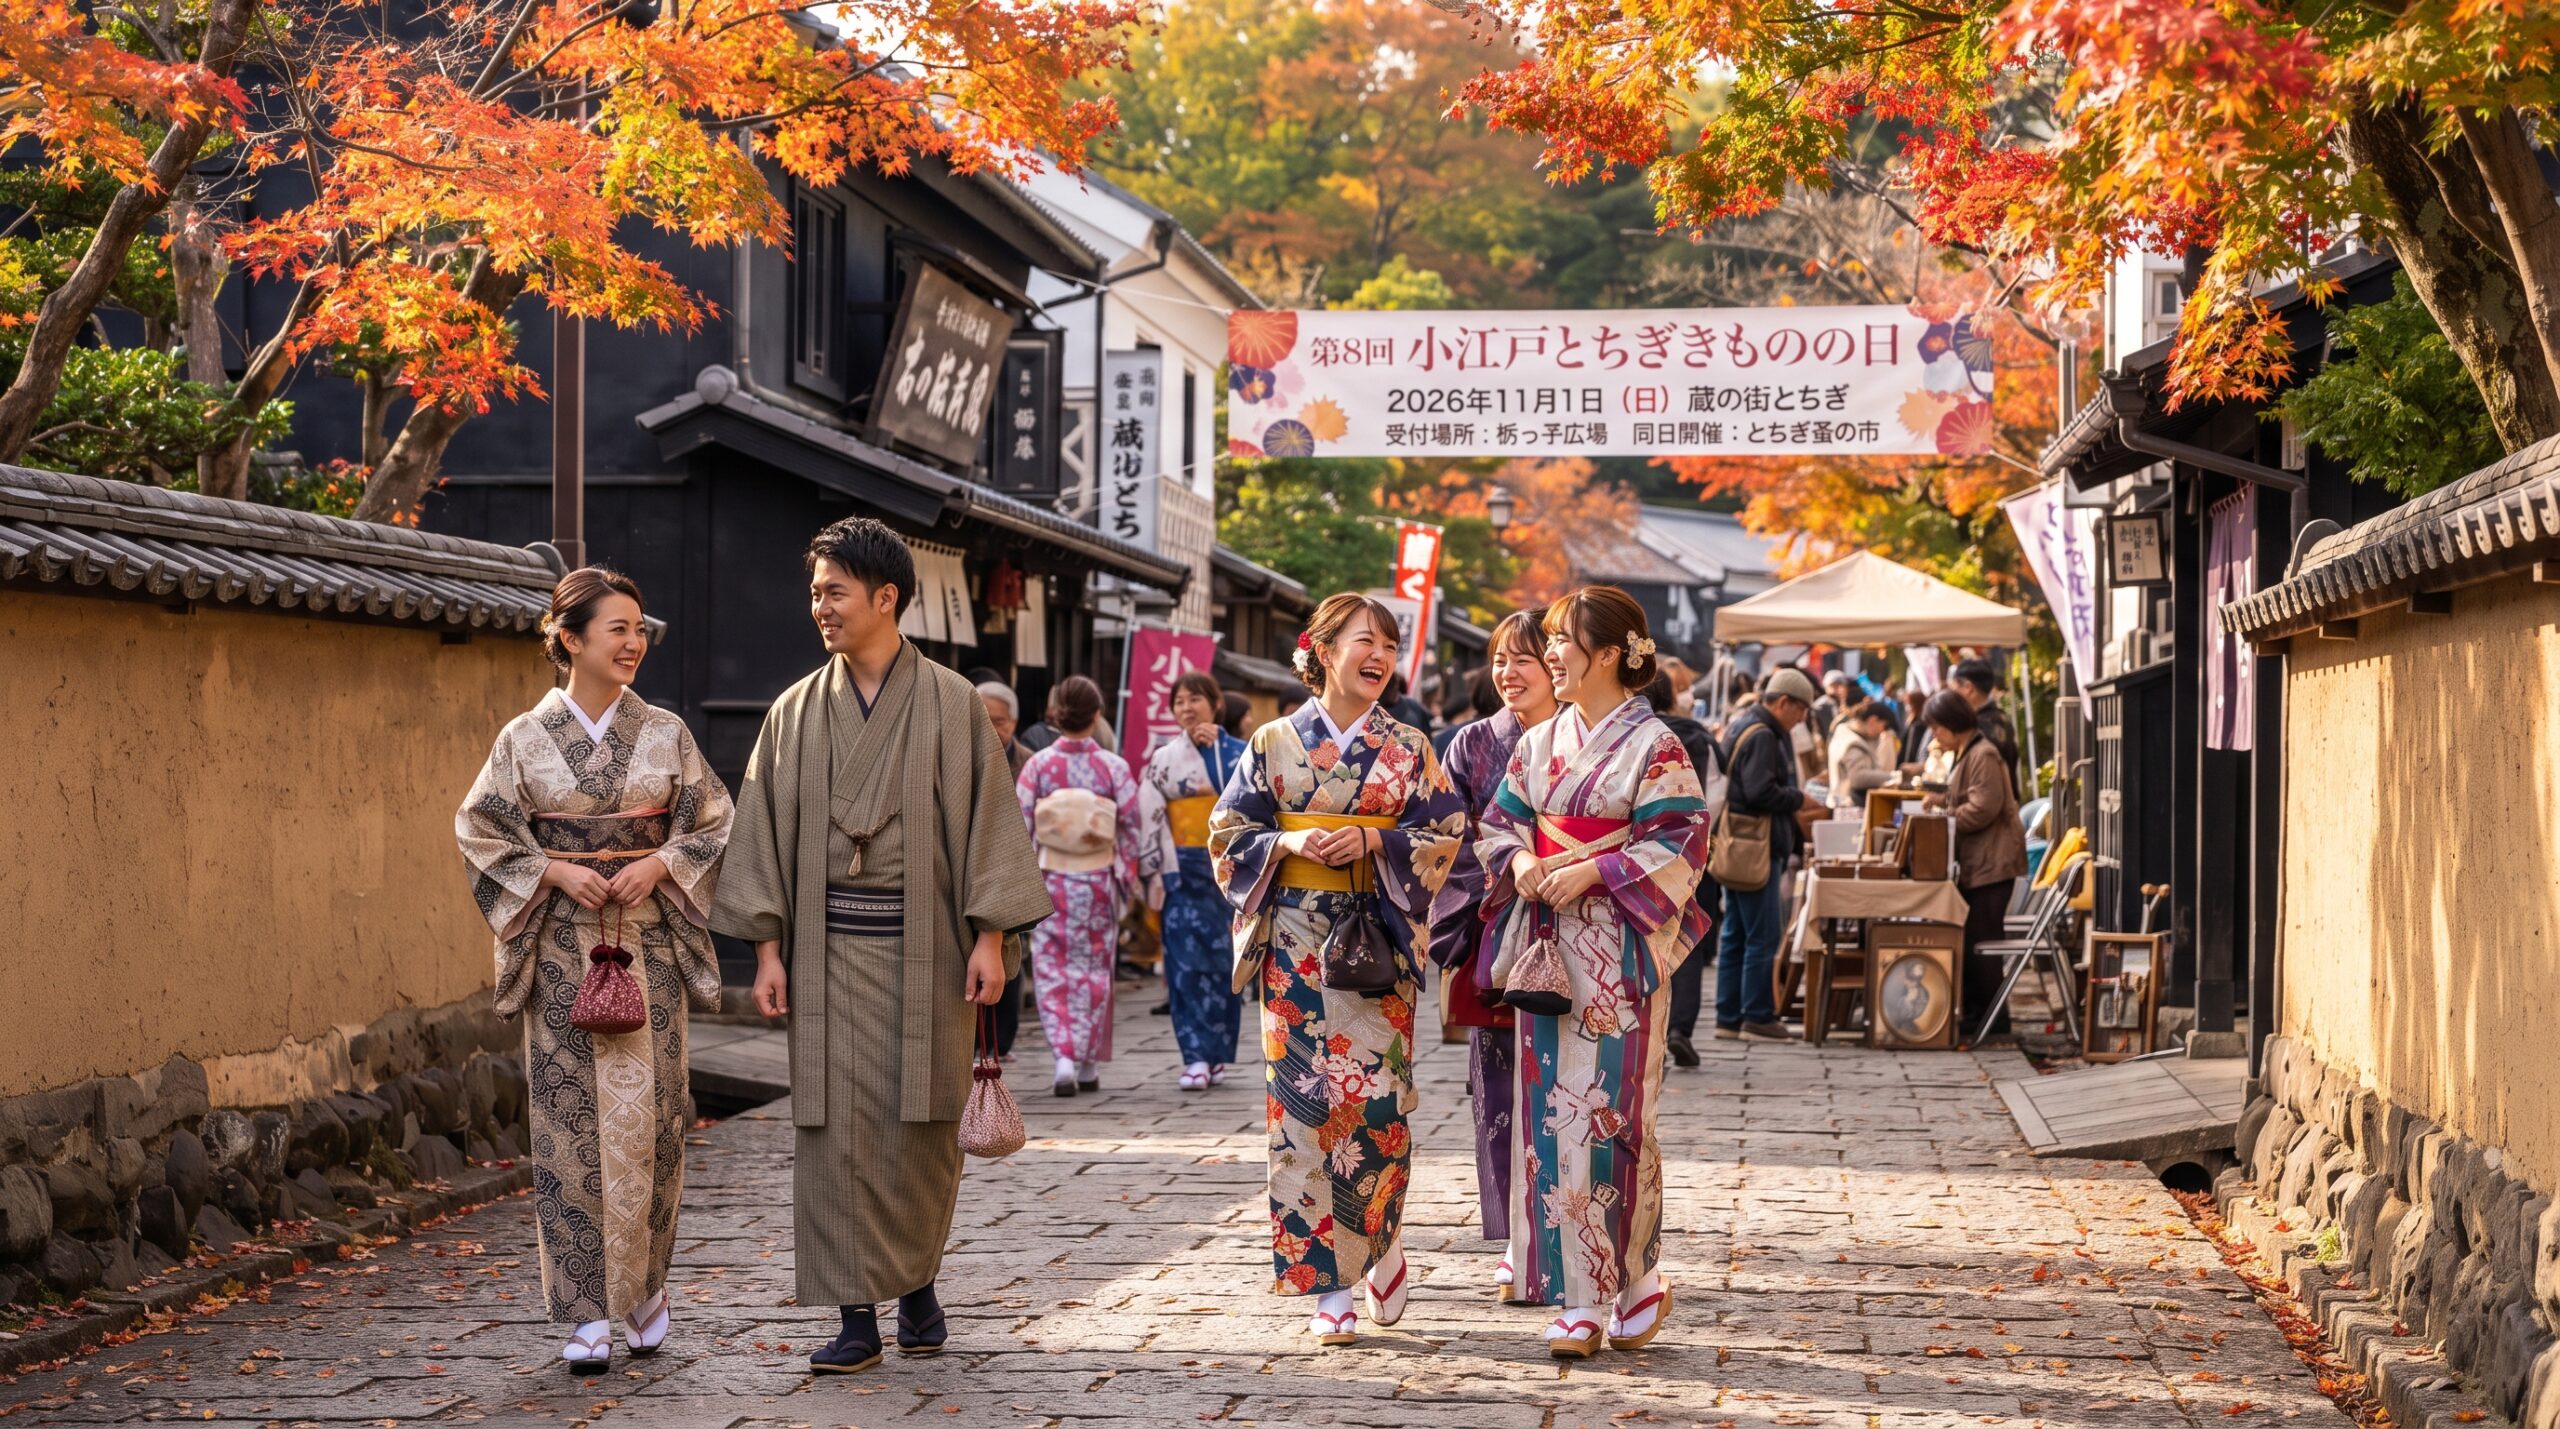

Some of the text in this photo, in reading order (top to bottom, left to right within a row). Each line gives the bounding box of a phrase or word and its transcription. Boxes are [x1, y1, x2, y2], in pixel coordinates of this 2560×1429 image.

[1310, 321, 1899, 372] 第8回 小江戸とちぎきものの日
[1687, 383, 1850, 413] 蔵の街とちぎ
[1633, 420, 1881, 446] 同日開催：とちぎ蚤の市
